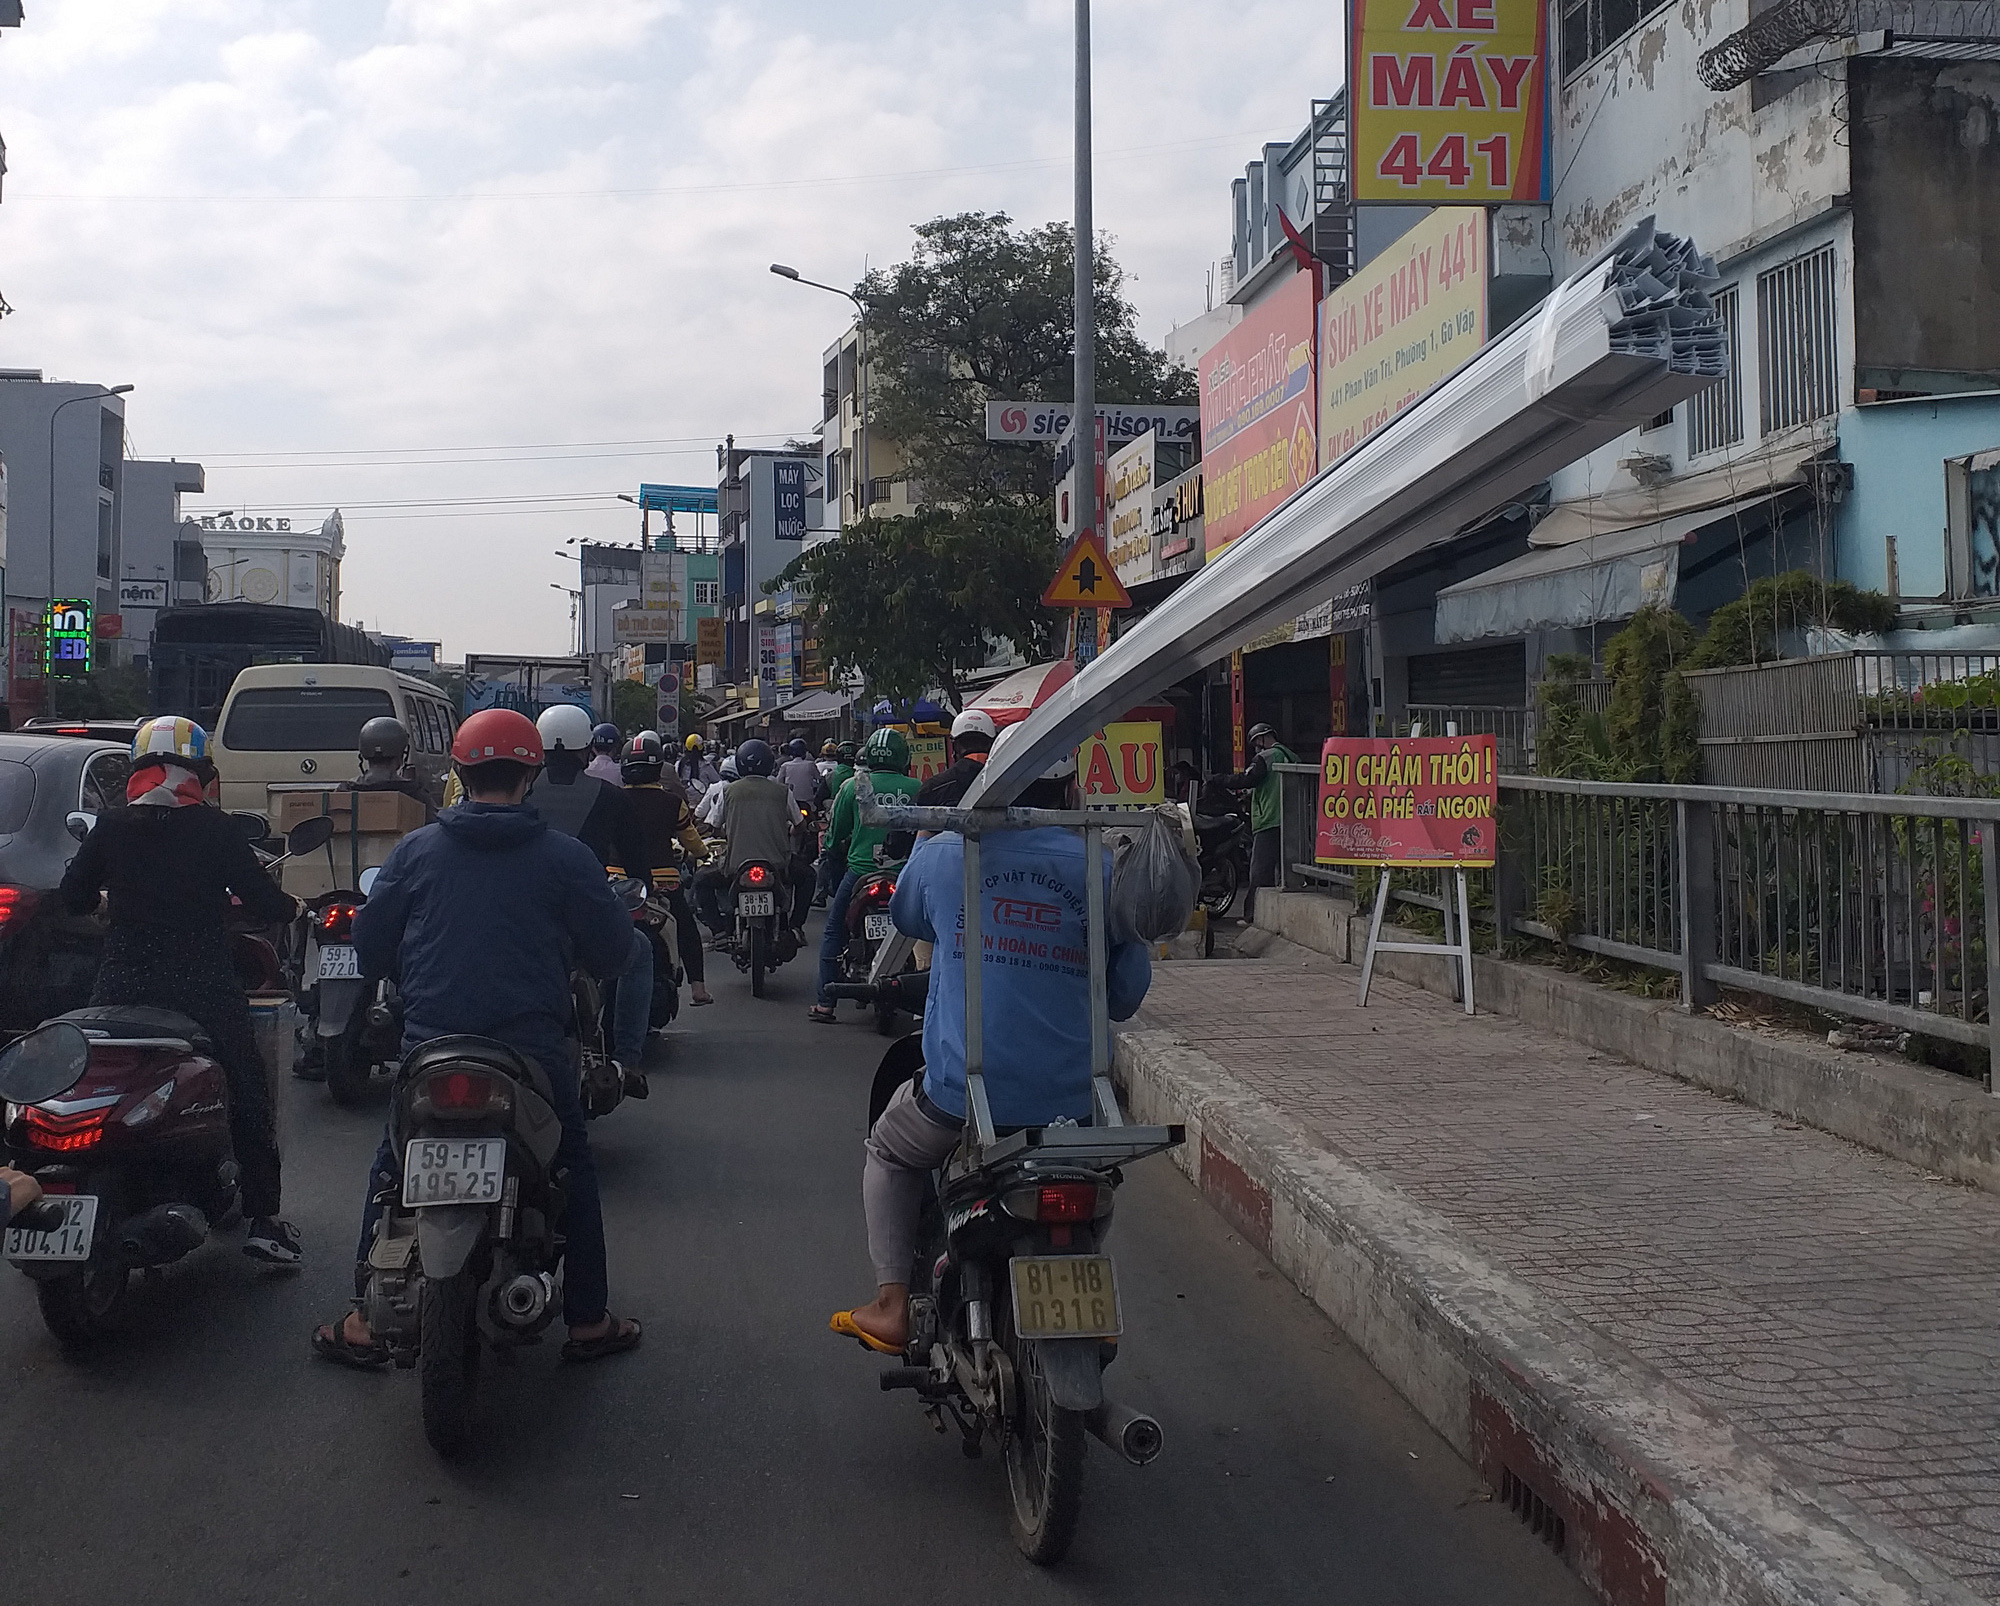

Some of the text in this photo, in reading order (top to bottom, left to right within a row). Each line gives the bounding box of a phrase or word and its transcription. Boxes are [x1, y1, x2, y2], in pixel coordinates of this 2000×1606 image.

[1403, 0, 1497, 31] XE
[1371, 43, 1534, 109] MÁY
[1379, 134, 1508, 187] 441
[1328, 296, 1358, 369] SỬA
[1363, 282, 1384, 347] XE
[1390, 243, 1432, 328] MÁY
[1438, 212, 1478, 292] 441
[1330, 388, 1343, 410] 441
[1344, 378, 1363, 402] Phan
[1395, 341, 1427, 373] Phường
[1441, 318, 1453, 346] Gò
[1456, 304, 1475, 336] Vấp
[779, 465, 799, 484] MÁY
[781, 493, 799, 511] LỌC
[1174, 485, 1181, 524] 3
[1182, 475, 1201, 521] HUY
[183, 514, 291, 531] RAOKE
[760, 649, 775, 664] 3G
[762, 667, 776, 681] 4G
[870, 746, 892, 757] Grab
[1326, 755, 1350, 785] ĐI
[1356, 744, 1422, 795] CHẬM
[1430, 742, 1480, 787] THÔI
[874, 788, 911, 806] rab
[1325, 789, 1490, 819] CÓ CÀ PHÊ RẤT NGON
[985, 875, 999, 888] CP
[1003, 869, 1025, 884] VẬT
[1047, 879, 1065, 894] CƠ
[1062, 889, 1086, 917] ĐIỆN
[744, 904, 769, 914] 9020
[871, 916, 892, 926] 59-E
[868, 926, 887, 938] 055
[327, 947, 354, 961] 59-Y
[998, 935, 1047, 958] HOÀNG
[320, 963, 355, 976] 672.0
[421, 1143, 488, 1170] 59-F1
[411, 1171, 497, 1200] 195.25
[1051, 1173, 1085, 1181] HONDA
